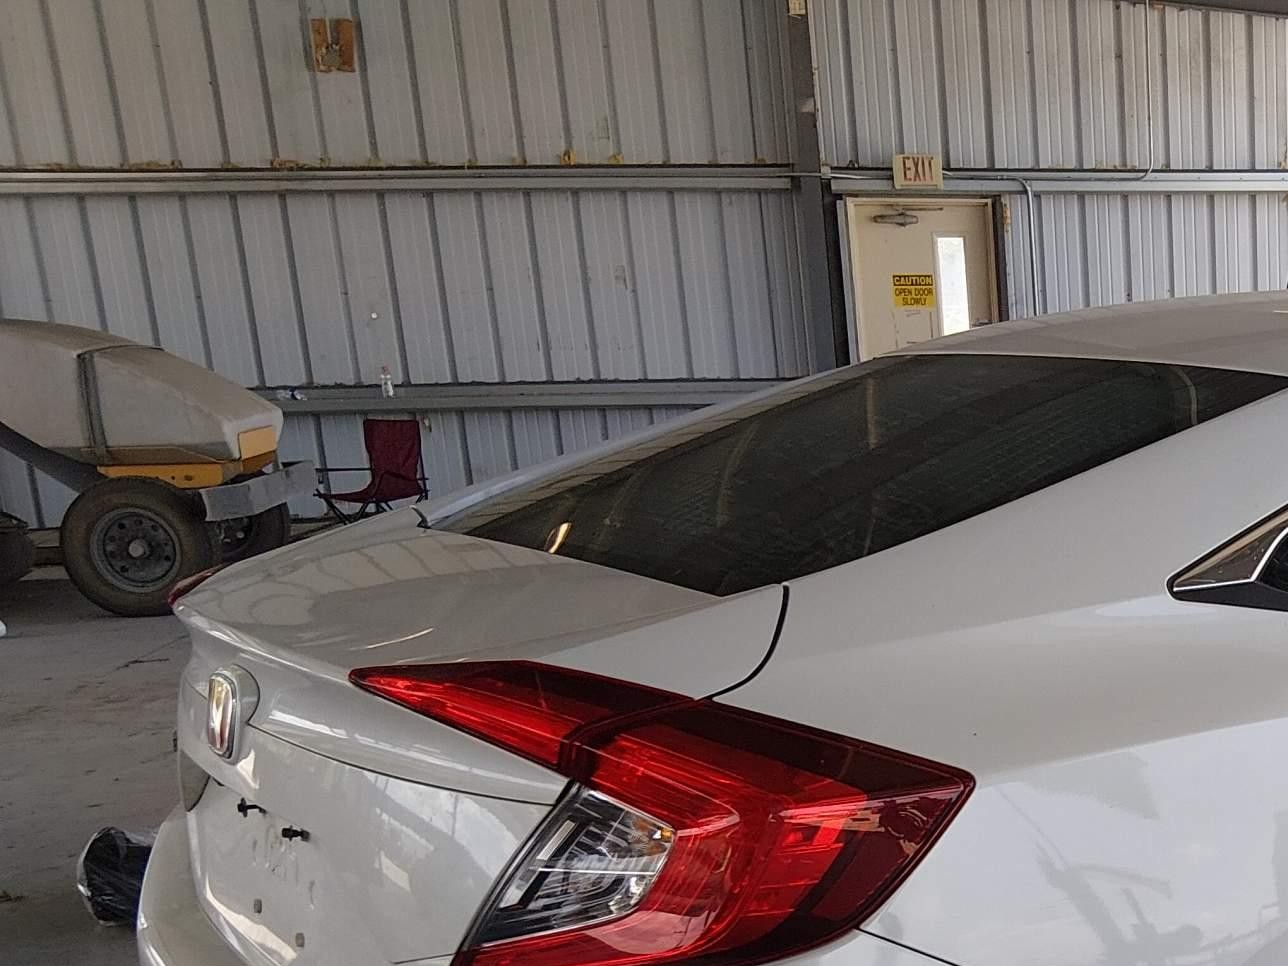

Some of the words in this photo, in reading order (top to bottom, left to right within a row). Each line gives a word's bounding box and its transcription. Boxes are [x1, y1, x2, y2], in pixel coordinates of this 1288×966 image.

[902, 156, 934, 182] EXIT
[894, 276, 933, 286] CAUTION
[894, 287, 913, 297] OPEN
[914, 287, 934, 297] DOOR
[902, 297, 927, 306] SLOWLY
